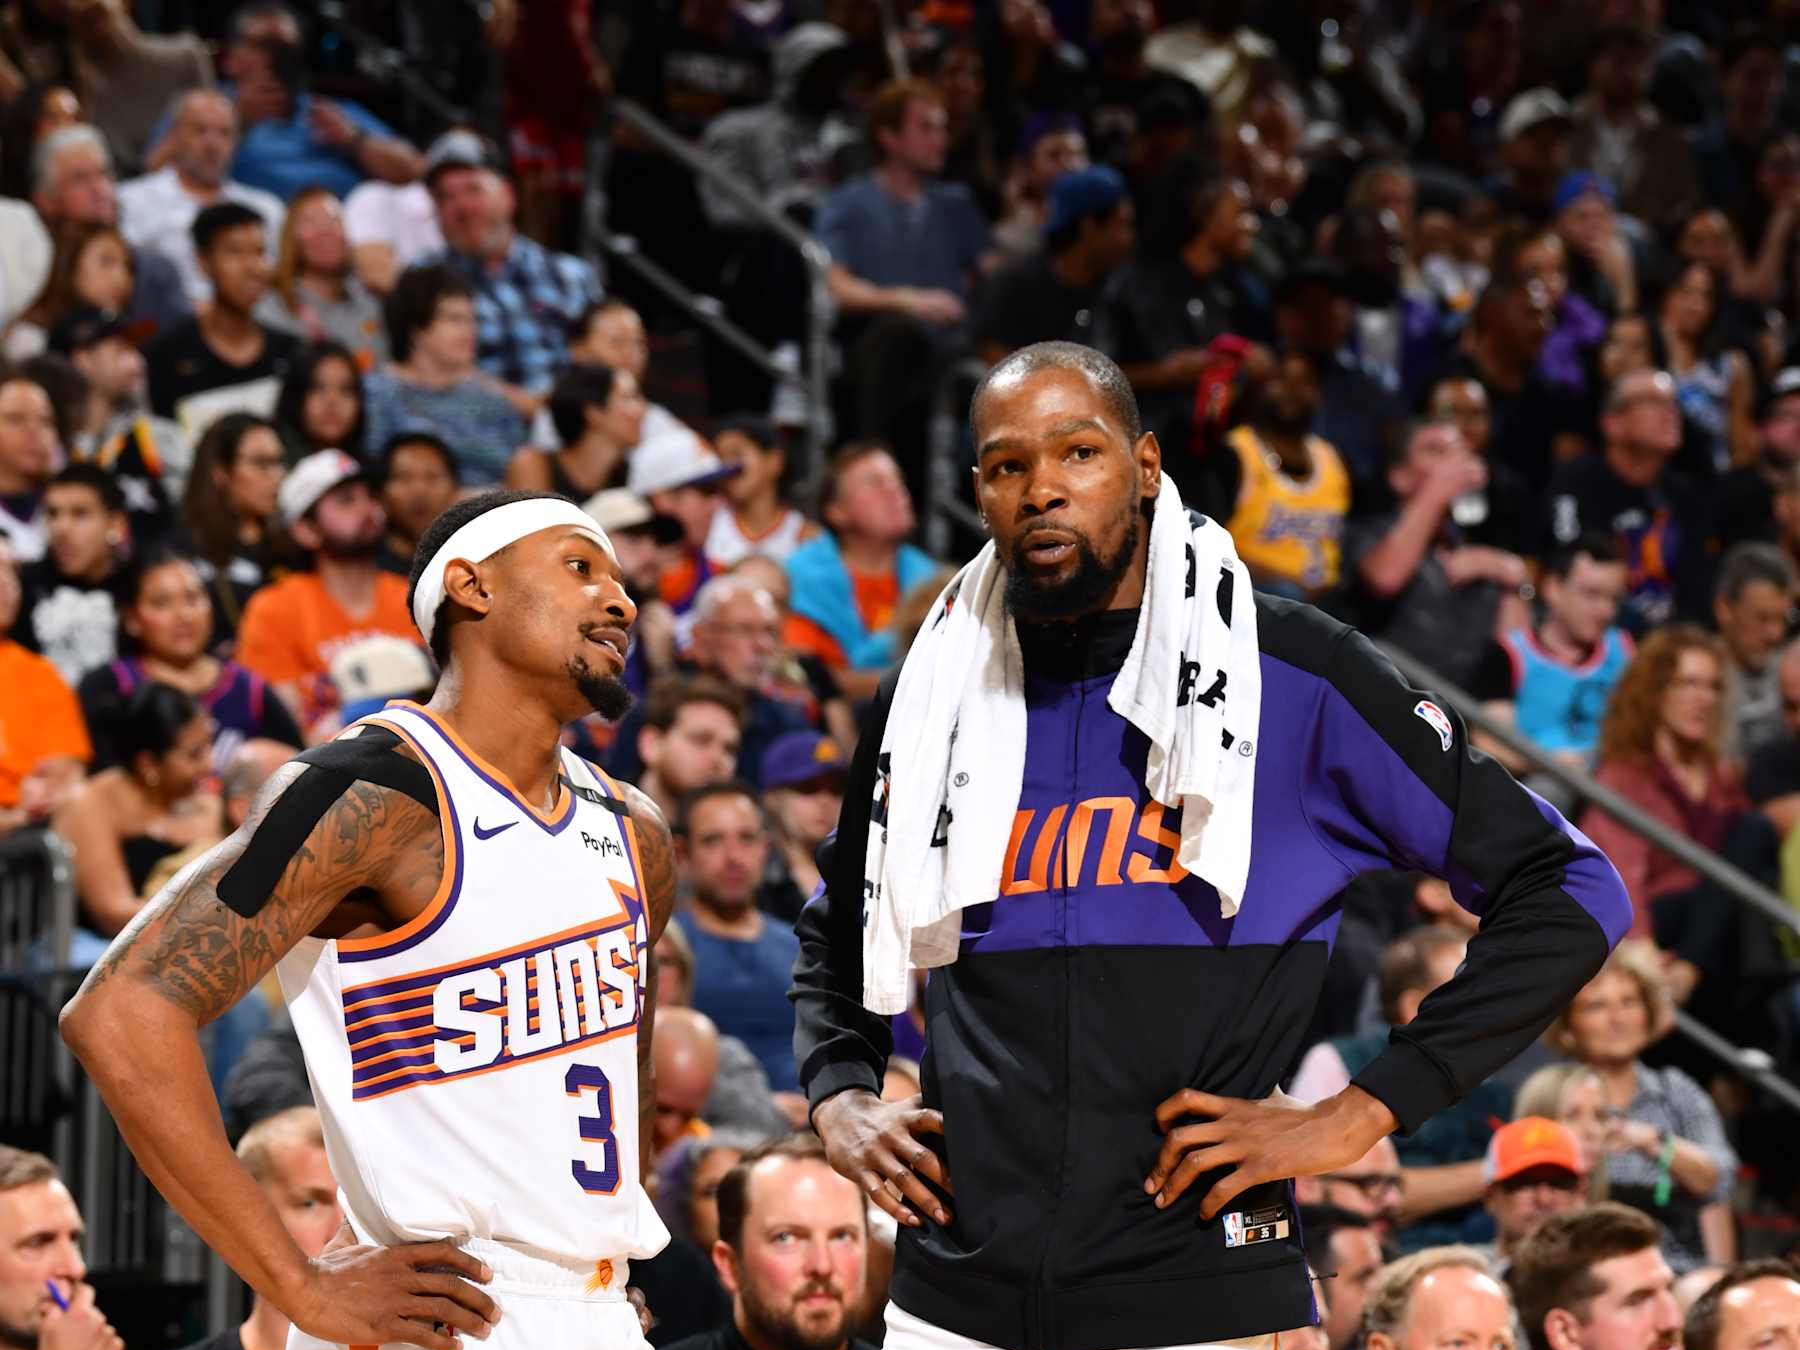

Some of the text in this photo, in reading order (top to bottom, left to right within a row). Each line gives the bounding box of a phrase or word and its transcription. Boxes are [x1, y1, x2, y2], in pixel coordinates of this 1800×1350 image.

[581, 831, 623, 857] PayPal
[1000, 796, 1190, 896] UNS
[432, 929, 637, 1074] SUNS
[565, 1063, 622, 1196] 3
